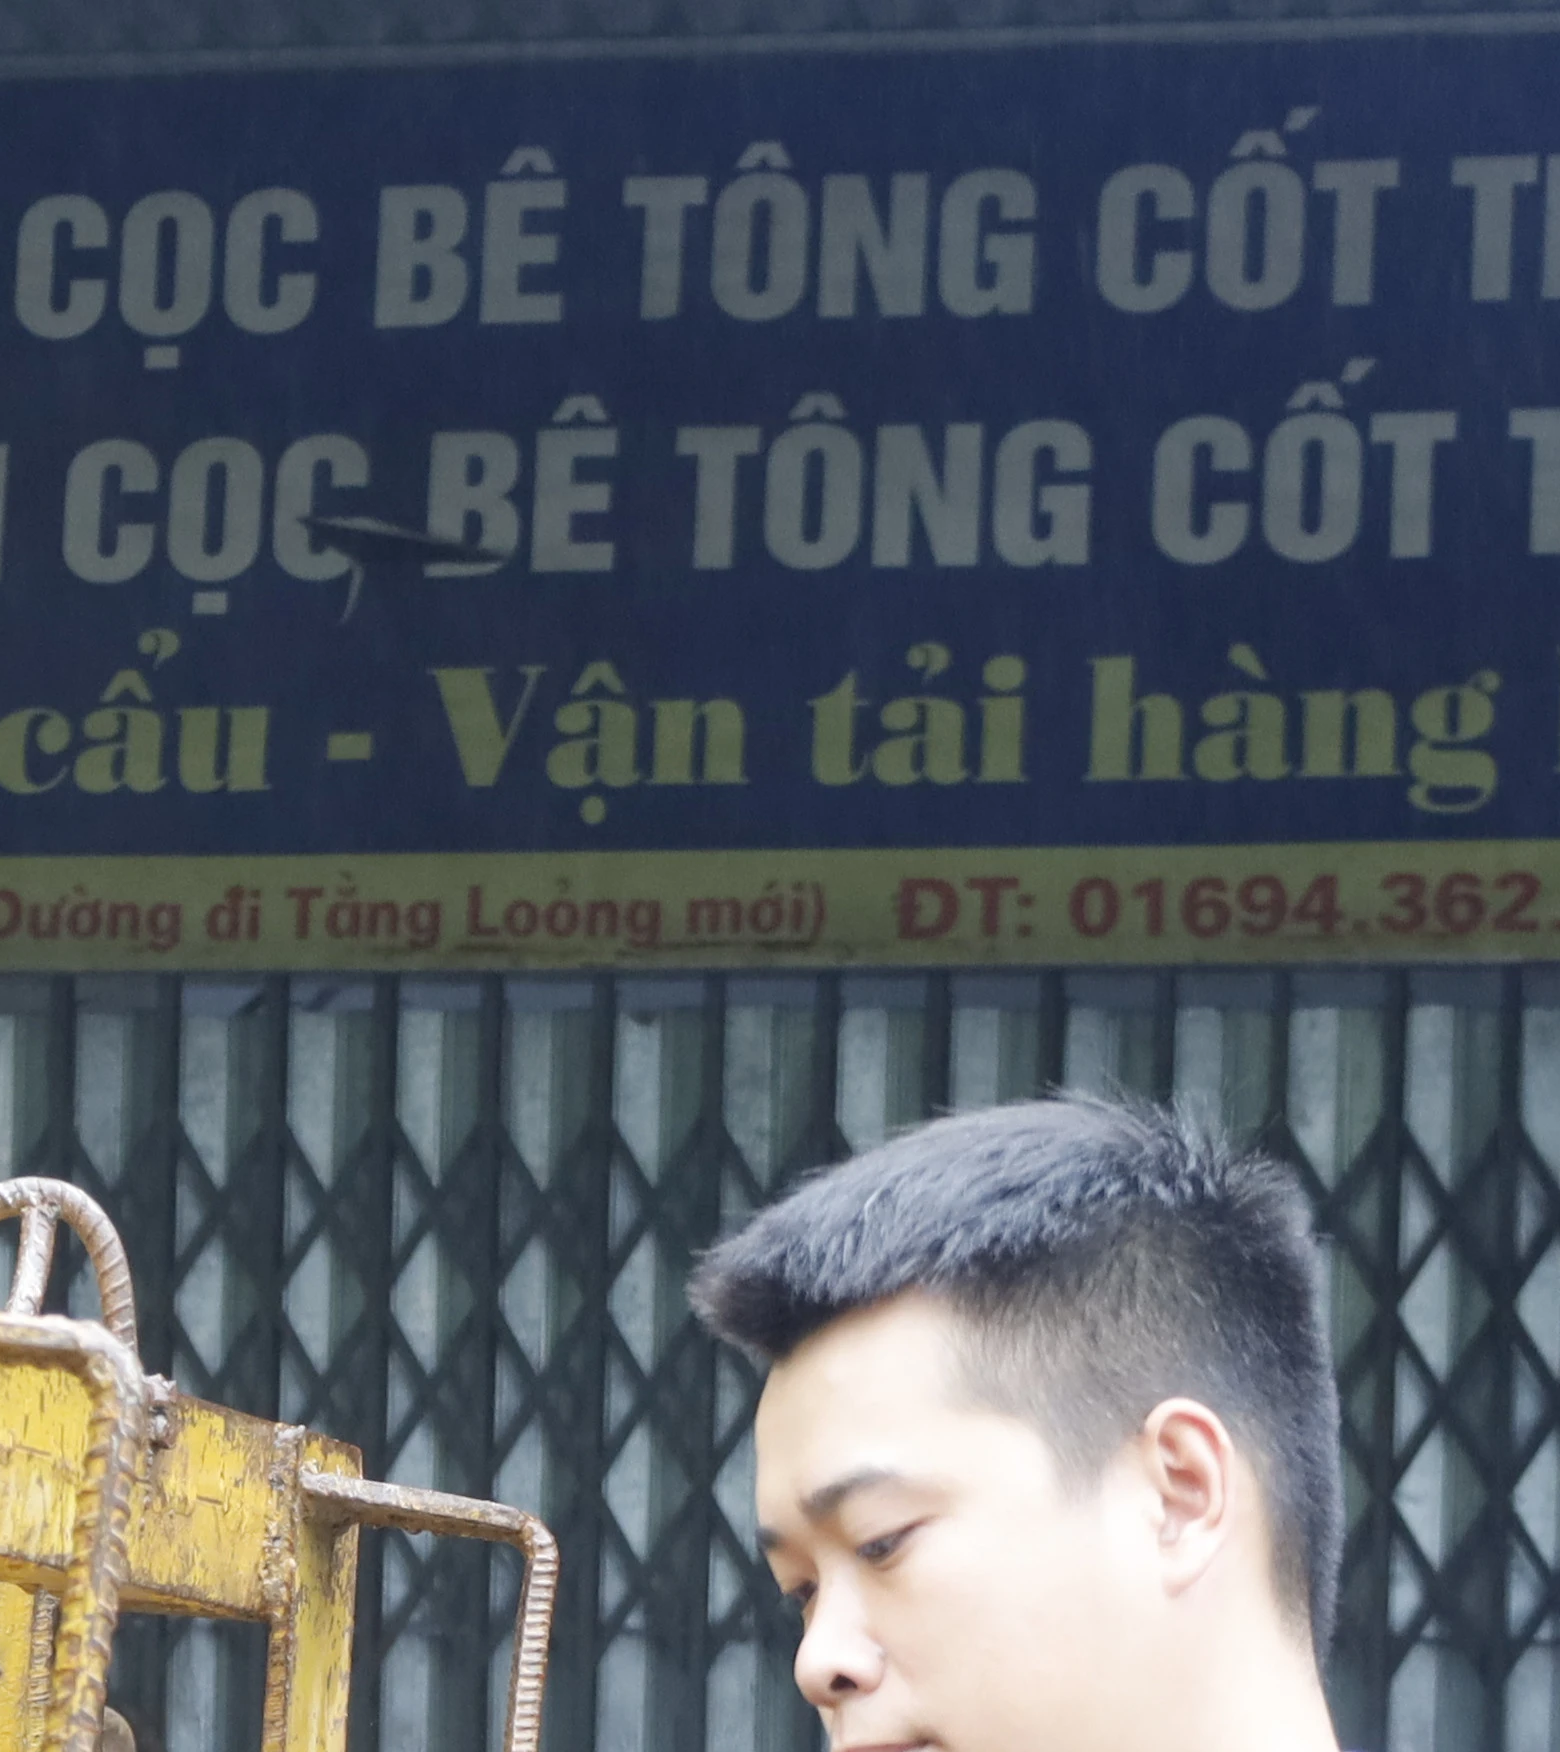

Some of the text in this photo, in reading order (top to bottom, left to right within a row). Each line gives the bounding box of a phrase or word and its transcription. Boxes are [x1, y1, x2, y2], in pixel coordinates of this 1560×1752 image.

[15, 188, 318, 369] CỌC
[375, 147, 566, 328] BÊ
[624, 142, 1036, 321] TÔNG
[1097, 107, 1399, 312] CỐT
[63, 434, 370, 614] CỌC
[425, 395, 618, 577] BÊ
[677, 394, 1091, 569] TÔNG
[1153, 359, 1457, 564] CỐT
[327, 733, 371, 760] -
[428, 661, 748, 824] Vận
[808, 643, 1025, 785] tải
[1086, 644, 1500, 812] hàng
[205, 885, 261, 942] đi
[685, 880, 826, 946] mới)
[893, 877, 1033, 941] ĐT:
